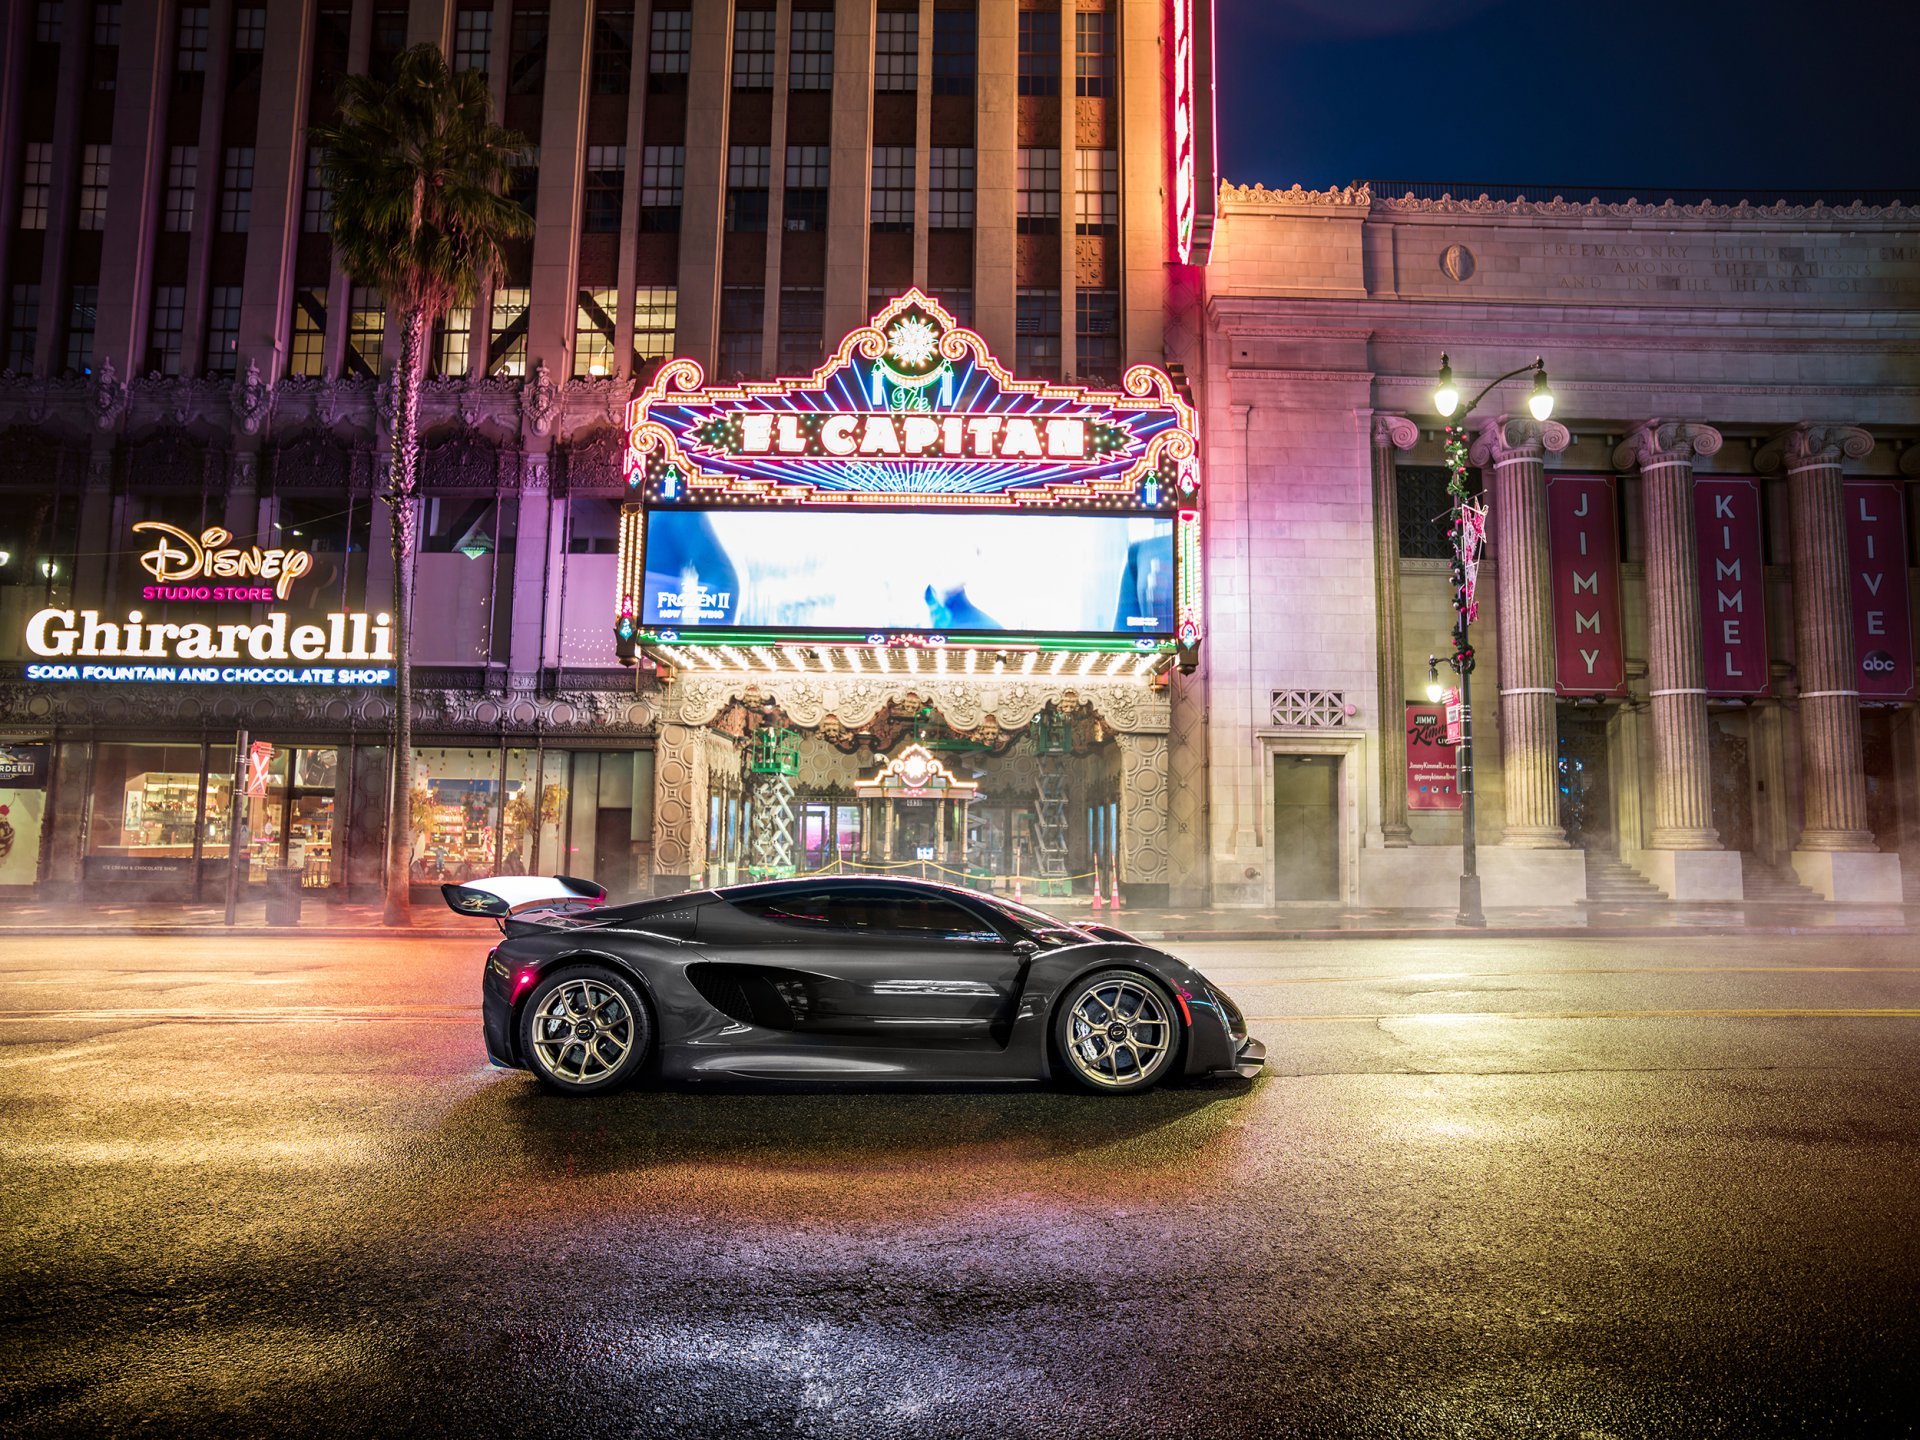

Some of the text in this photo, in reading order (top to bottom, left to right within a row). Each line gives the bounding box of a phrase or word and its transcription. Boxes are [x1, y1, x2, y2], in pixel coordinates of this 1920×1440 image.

[1543, 244, 1689, 259] FREEMASONRY
[1614, 262, 1872, 276] AMONG THE NATIONS
[1559, 276, 1602, 289] AND
[1627, 277, 1649, 290] IN
[1671, 278, 1713, 291] THE
[890, 386, 931, 411] The
[742, 413, 1085, 456] EL CAPITAN
[1859, 497, 1887, 635] LIVE
[1572, 492, 1601, 675] JIMMY
[1715, 494, 1743, 677] KIMMEL
[143, 586, 274, 601] STUDIO STORE
[657, 592, 717, 608] FROEN
[25, 608, 393, 660] Ghirardelli
[1862, 656, 1896, 672] abc
[27, 665, 391, 684] SODA FOUNTAIN AND CHOCOLATE SHOP
[1416, 716, 1436, 724] JIMMY
[1408, 724, 1447, 745] Kimm
